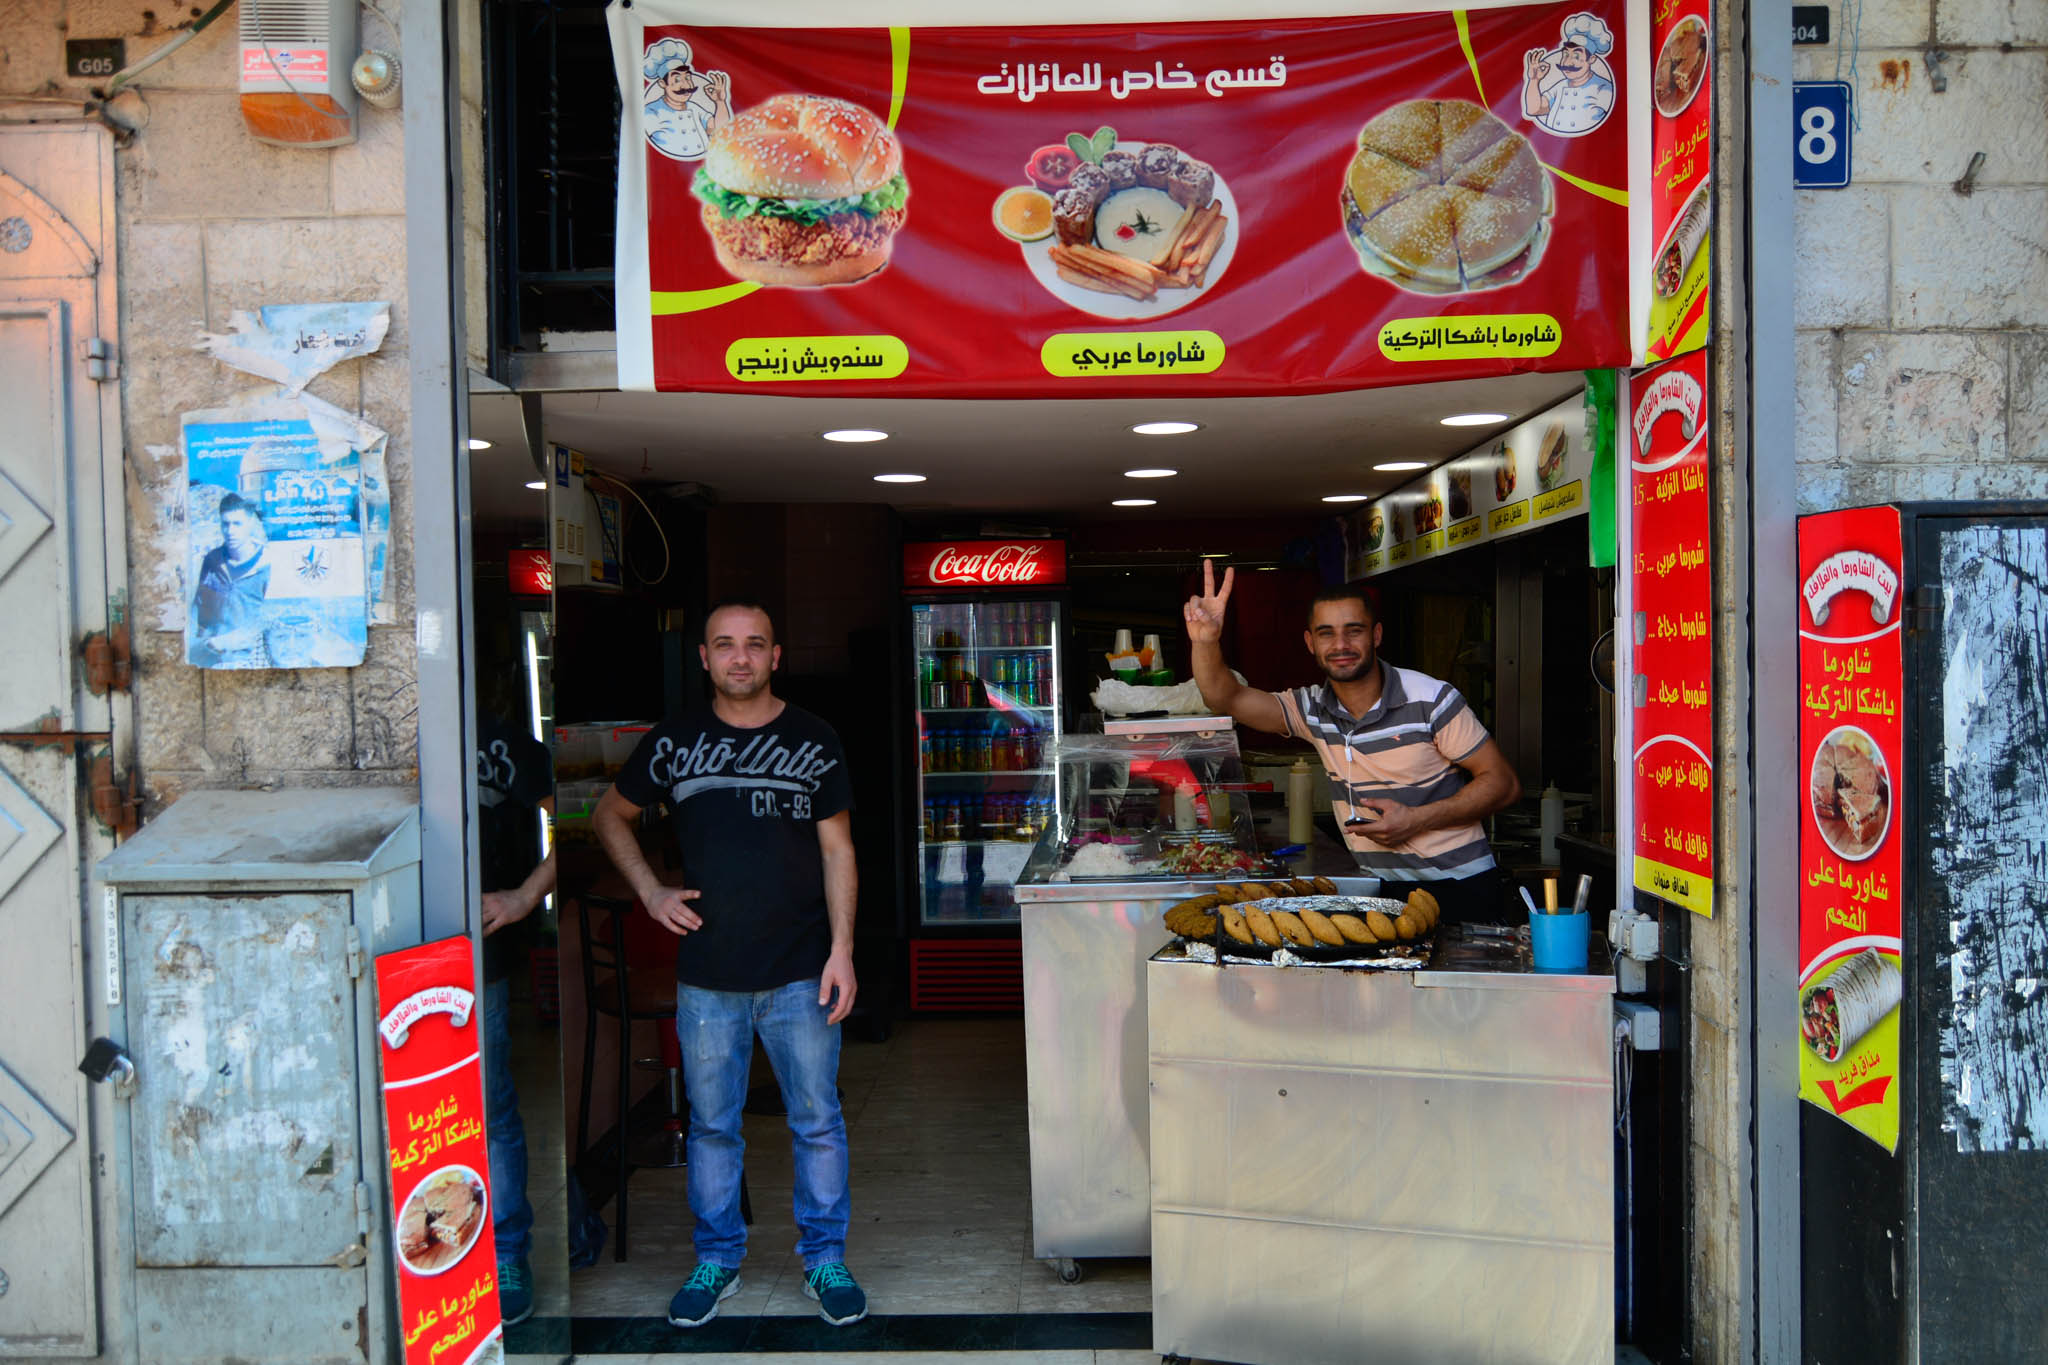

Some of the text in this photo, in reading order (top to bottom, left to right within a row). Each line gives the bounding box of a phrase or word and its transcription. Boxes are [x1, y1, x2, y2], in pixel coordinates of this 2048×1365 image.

[78, 58, 113, 73] G05
[977, 55, 1287, 103] قسم خاص للعائلات
[1654, 119, 1709, 177] شاورما على
[1799, 106, 1836, 164] 8
[1665, 158, 1694, 200] الفحم
[1384, 325, 1556, 351] شاورما باشكا التركية
[737, 346, 883, 375] سندويش زينجر
[1072, 341, 1205, 370] شاورما عربي
[1660, 376, 1684, 400] الشاورما
[1656, 470, 1679, 503] التركية
[1682, 464, 1704, 492] باشكا
[1633, 484, 1644, 506] 15
[929, 545, 1043, 583] Coca-Cola
[1634, 553, 1645, 575] 15
[1657, 552, 1677, 578] عربي
[1679, 539, 1705, 571] شورما
[1808, 558, 1893, 599] بيت الشاورما والفلافل
[1657, 614, 1678, 642] دجاج
[1680, 611, 1707, 641] شاورما
[1823, 647, 1871, 681] شاورما
[1659, 679, 1679, 709] عجل
[1682, 680, 1708, 710] شورما
[1806, 683, 1895, 723] باشكا التركية
[1638, 757, 1645, 777] 6
[1656, 765, 1673, 788] عربي
[1674, 759, 1687, 788] خبز
[1688, 762, 1709, 793] فلافل
[1640, 823, 1647, 842] 4
[1664, 827, 1683, 852] كماج
[1685, 834, 1708, 862] فلافل
[1808, 855, 1888, 904] شاورما على
[1826, 905, 1866, 933] الفحم
[420, 991, 451, 1008] الشاورما
[388, 1002, 418, 1034] والفلافل
[1838, 1048, 1881, 1085] مذاق فريد
[408, 1094, 458, 1133] شاورما
[391, 1117, 482, 1173] باشكا التركية
[406, 1272, 494, 1346] شاورما على
[430, 1314, 476, 1365] الفحم
